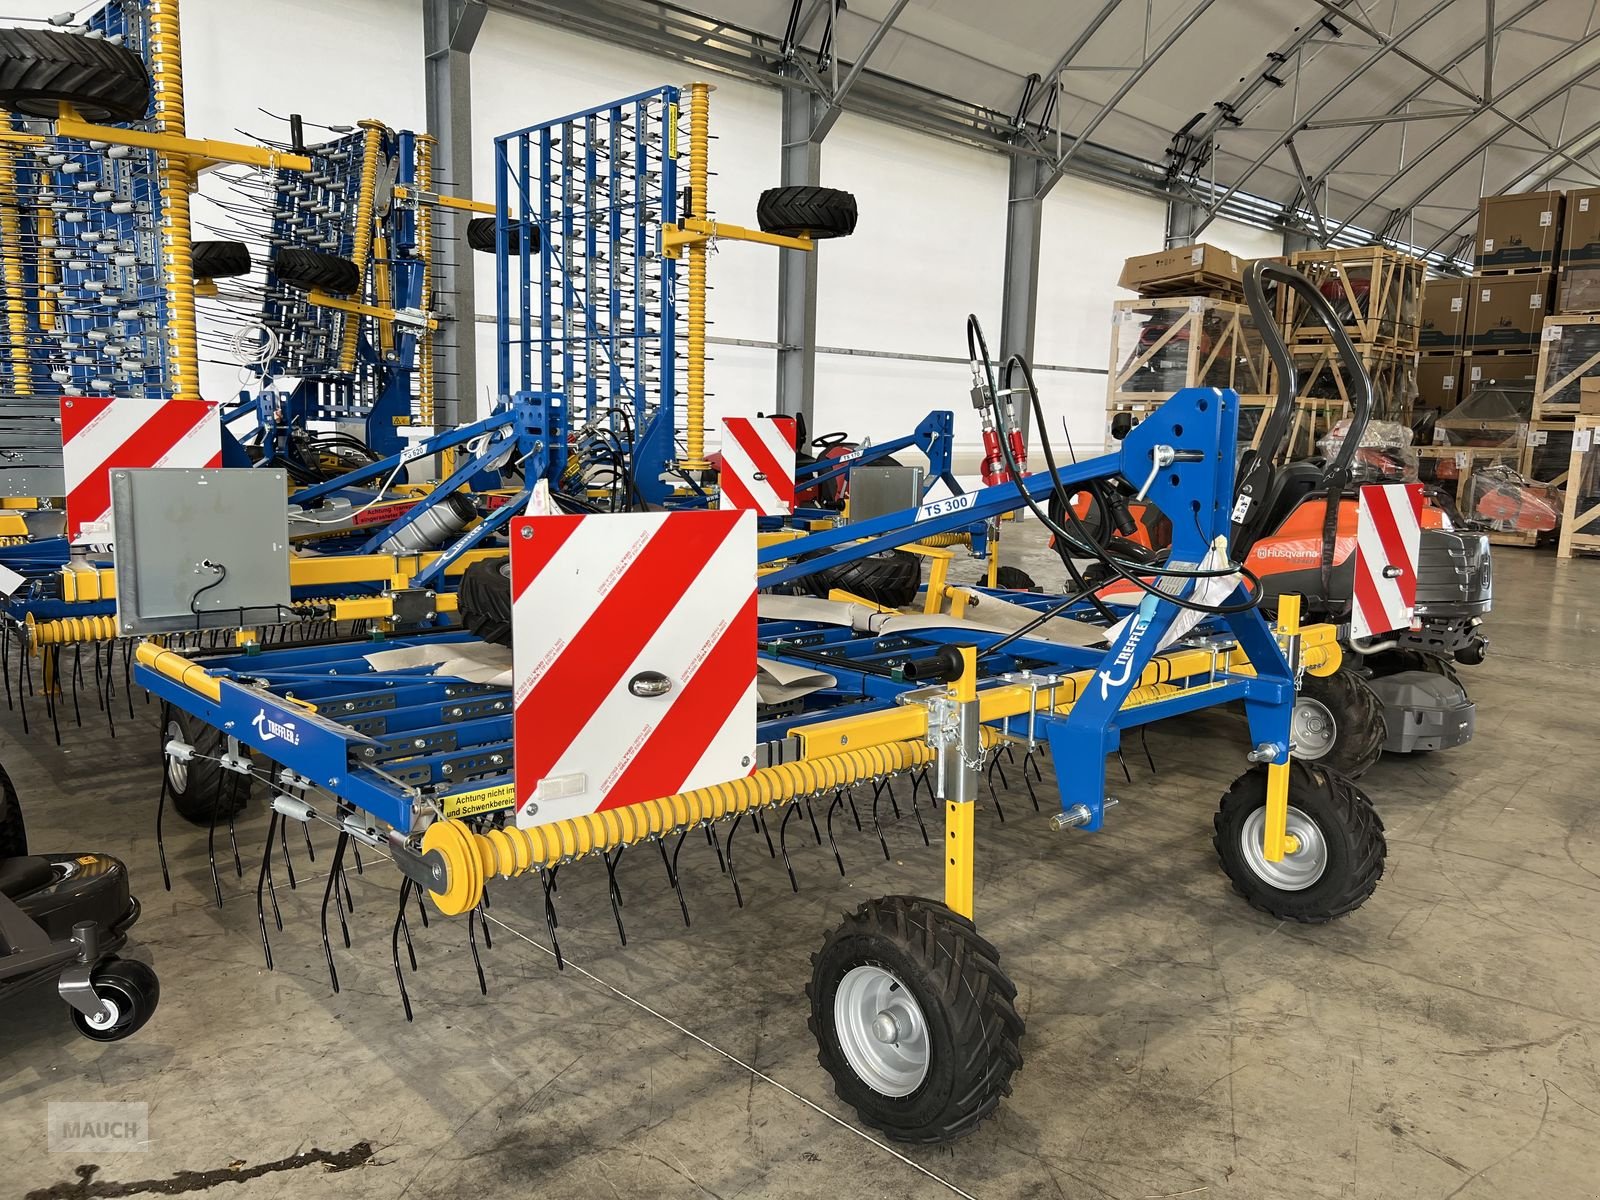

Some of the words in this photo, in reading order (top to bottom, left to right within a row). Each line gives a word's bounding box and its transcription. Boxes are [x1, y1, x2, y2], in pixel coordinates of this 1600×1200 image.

[924, 504, 941, 516] TS
[945, 497, 968, 511] 300
[1268, 549, 1318, 558] Husqvarna
[1114, 619, 1150, 666] TREFFLE
[268, 719, 294, 744] TREFFLER
[456, 794, 486, 805] Achtung
[488, 789, 505, 798] nicht
[446, 808, 460, 818] und
